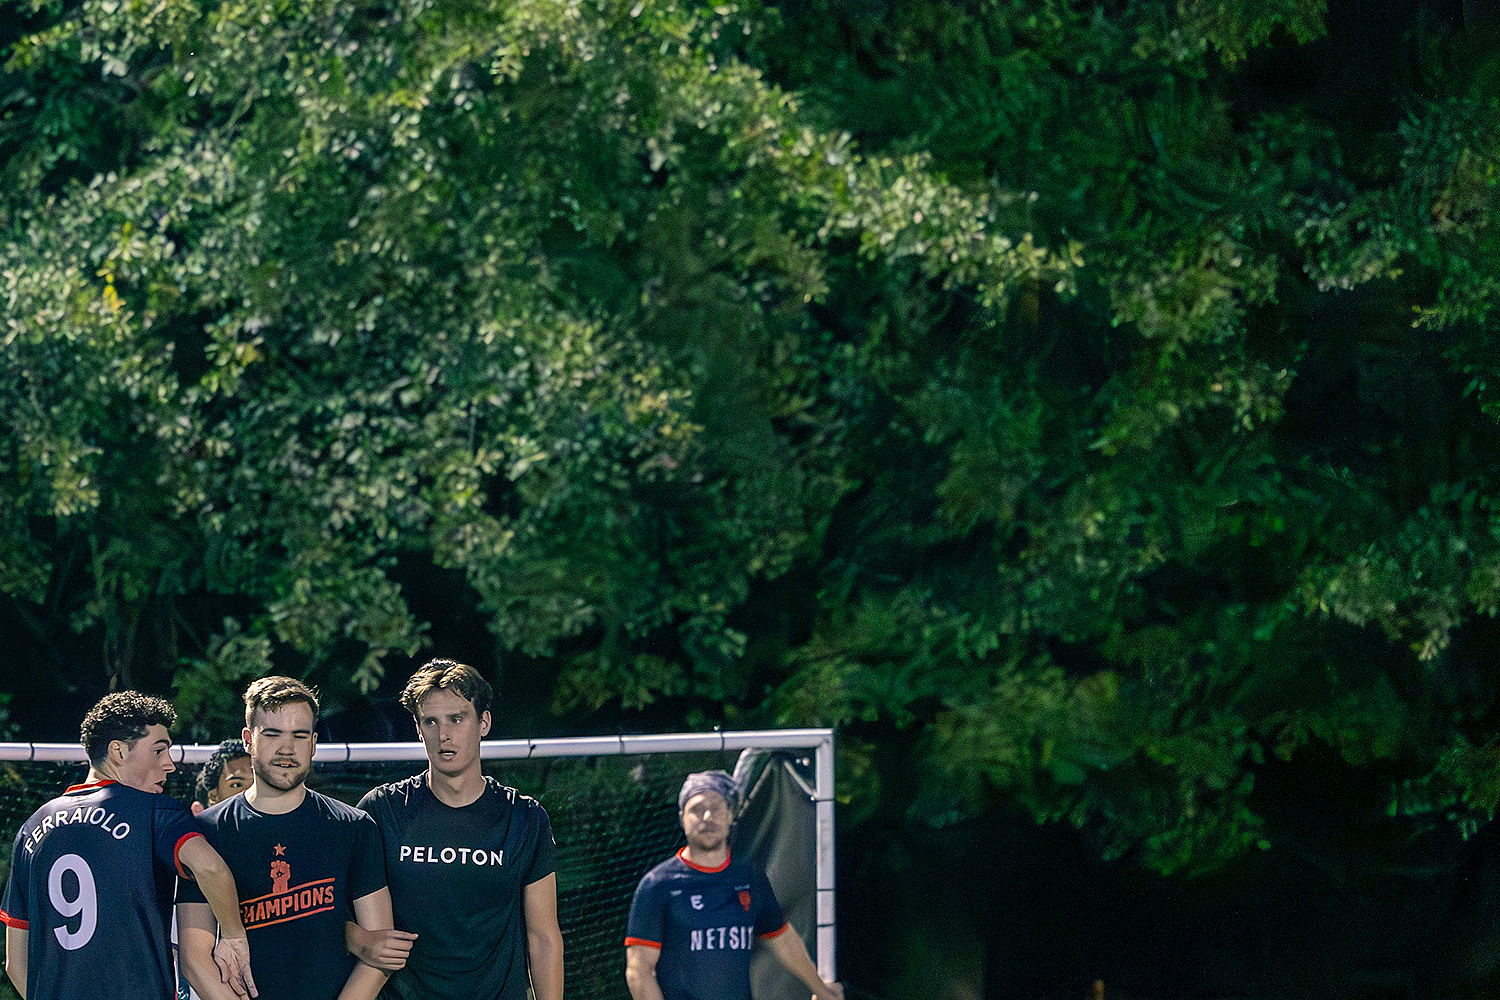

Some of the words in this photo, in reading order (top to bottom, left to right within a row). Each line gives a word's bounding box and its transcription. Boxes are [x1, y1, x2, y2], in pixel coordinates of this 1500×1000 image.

[24, 806, 131, 854] FERRAIOLO
[399, 845, 504, 866] PELOTON
[48, 853, 98, 951] 9
[241, 885, 334, 924] HAMPIONS
